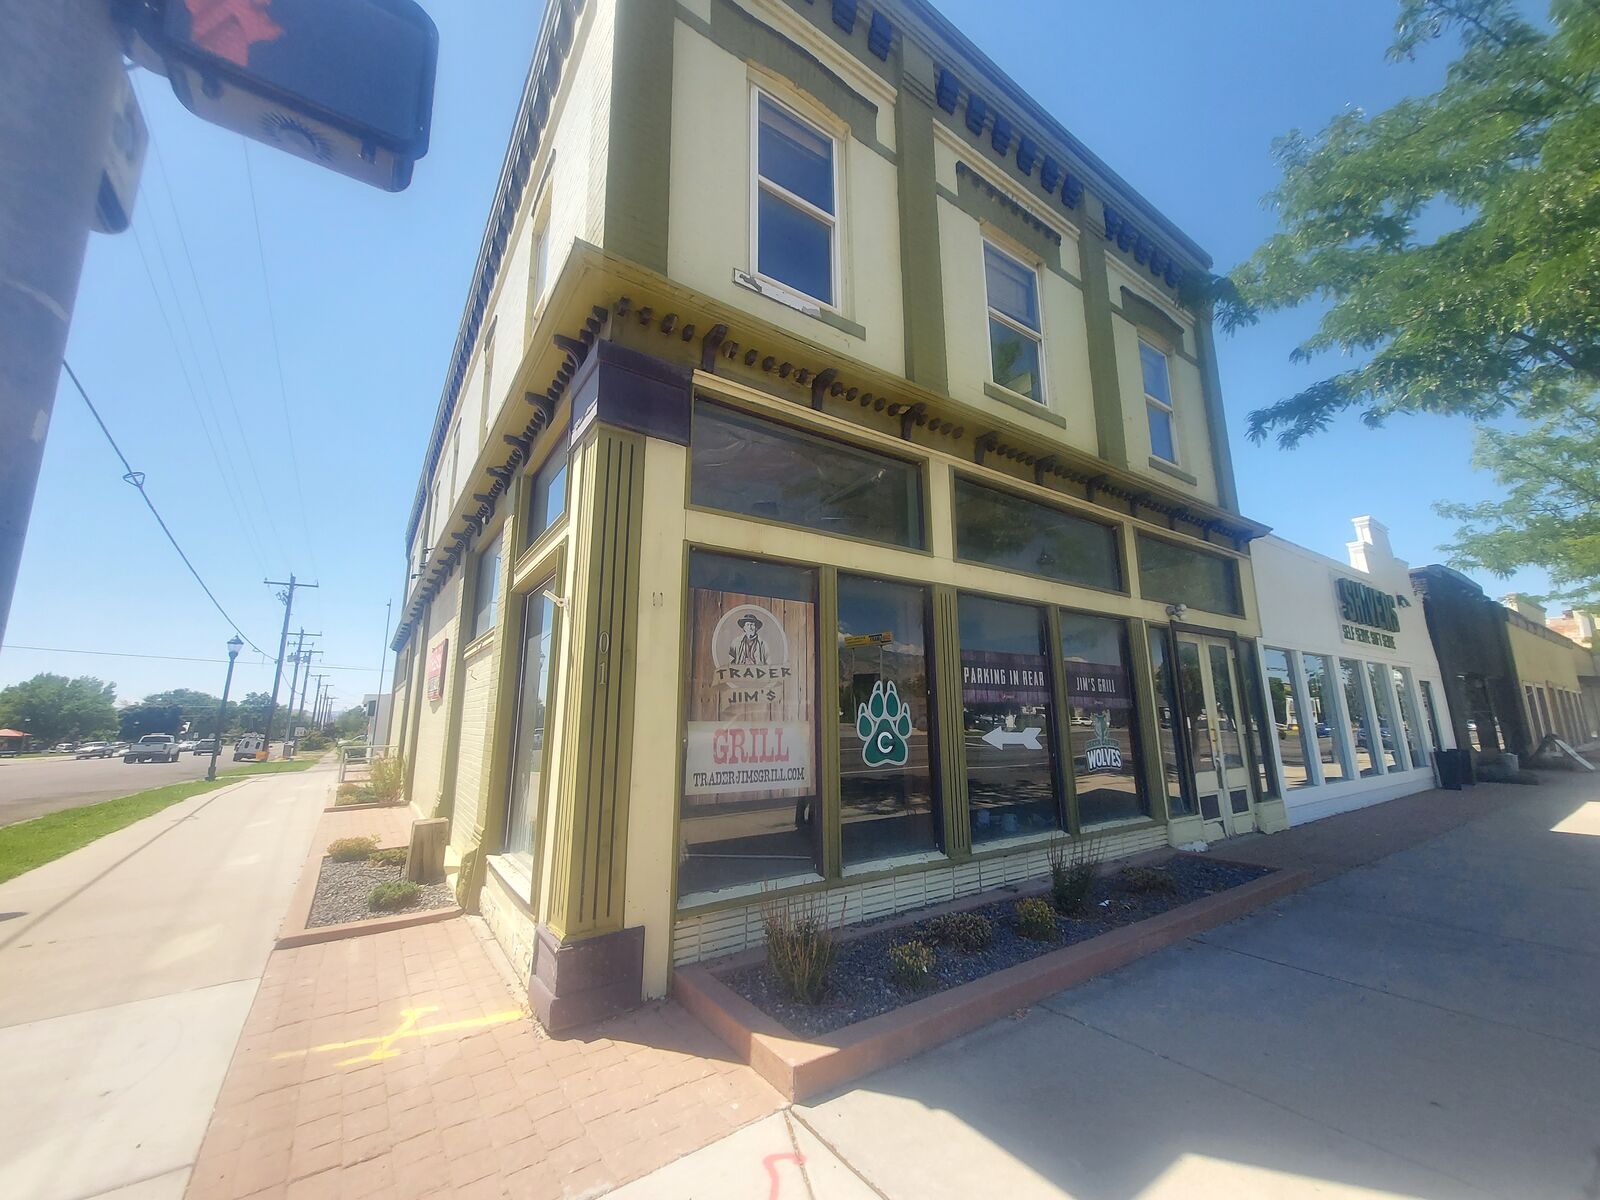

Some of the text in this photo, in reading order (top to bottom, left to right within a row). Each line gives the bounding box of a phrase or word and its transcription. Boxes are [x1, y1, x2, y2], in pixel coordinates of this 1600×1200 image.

[716, 666, 792, 680] TRADER
[964, 667, 1045, 687] PARKING IN REAR
[1076, 677, 1116, 693] JIM'S GRILL
[728, 690, 777, 704] JIM'S
[712, 727, 790, 765] GRILL
[877, 731, 894, 754] C
[1087, 748, 1122, 769] WOLVES
[693, 767, 806, 788] TRADERJIMSGRILL.COM
